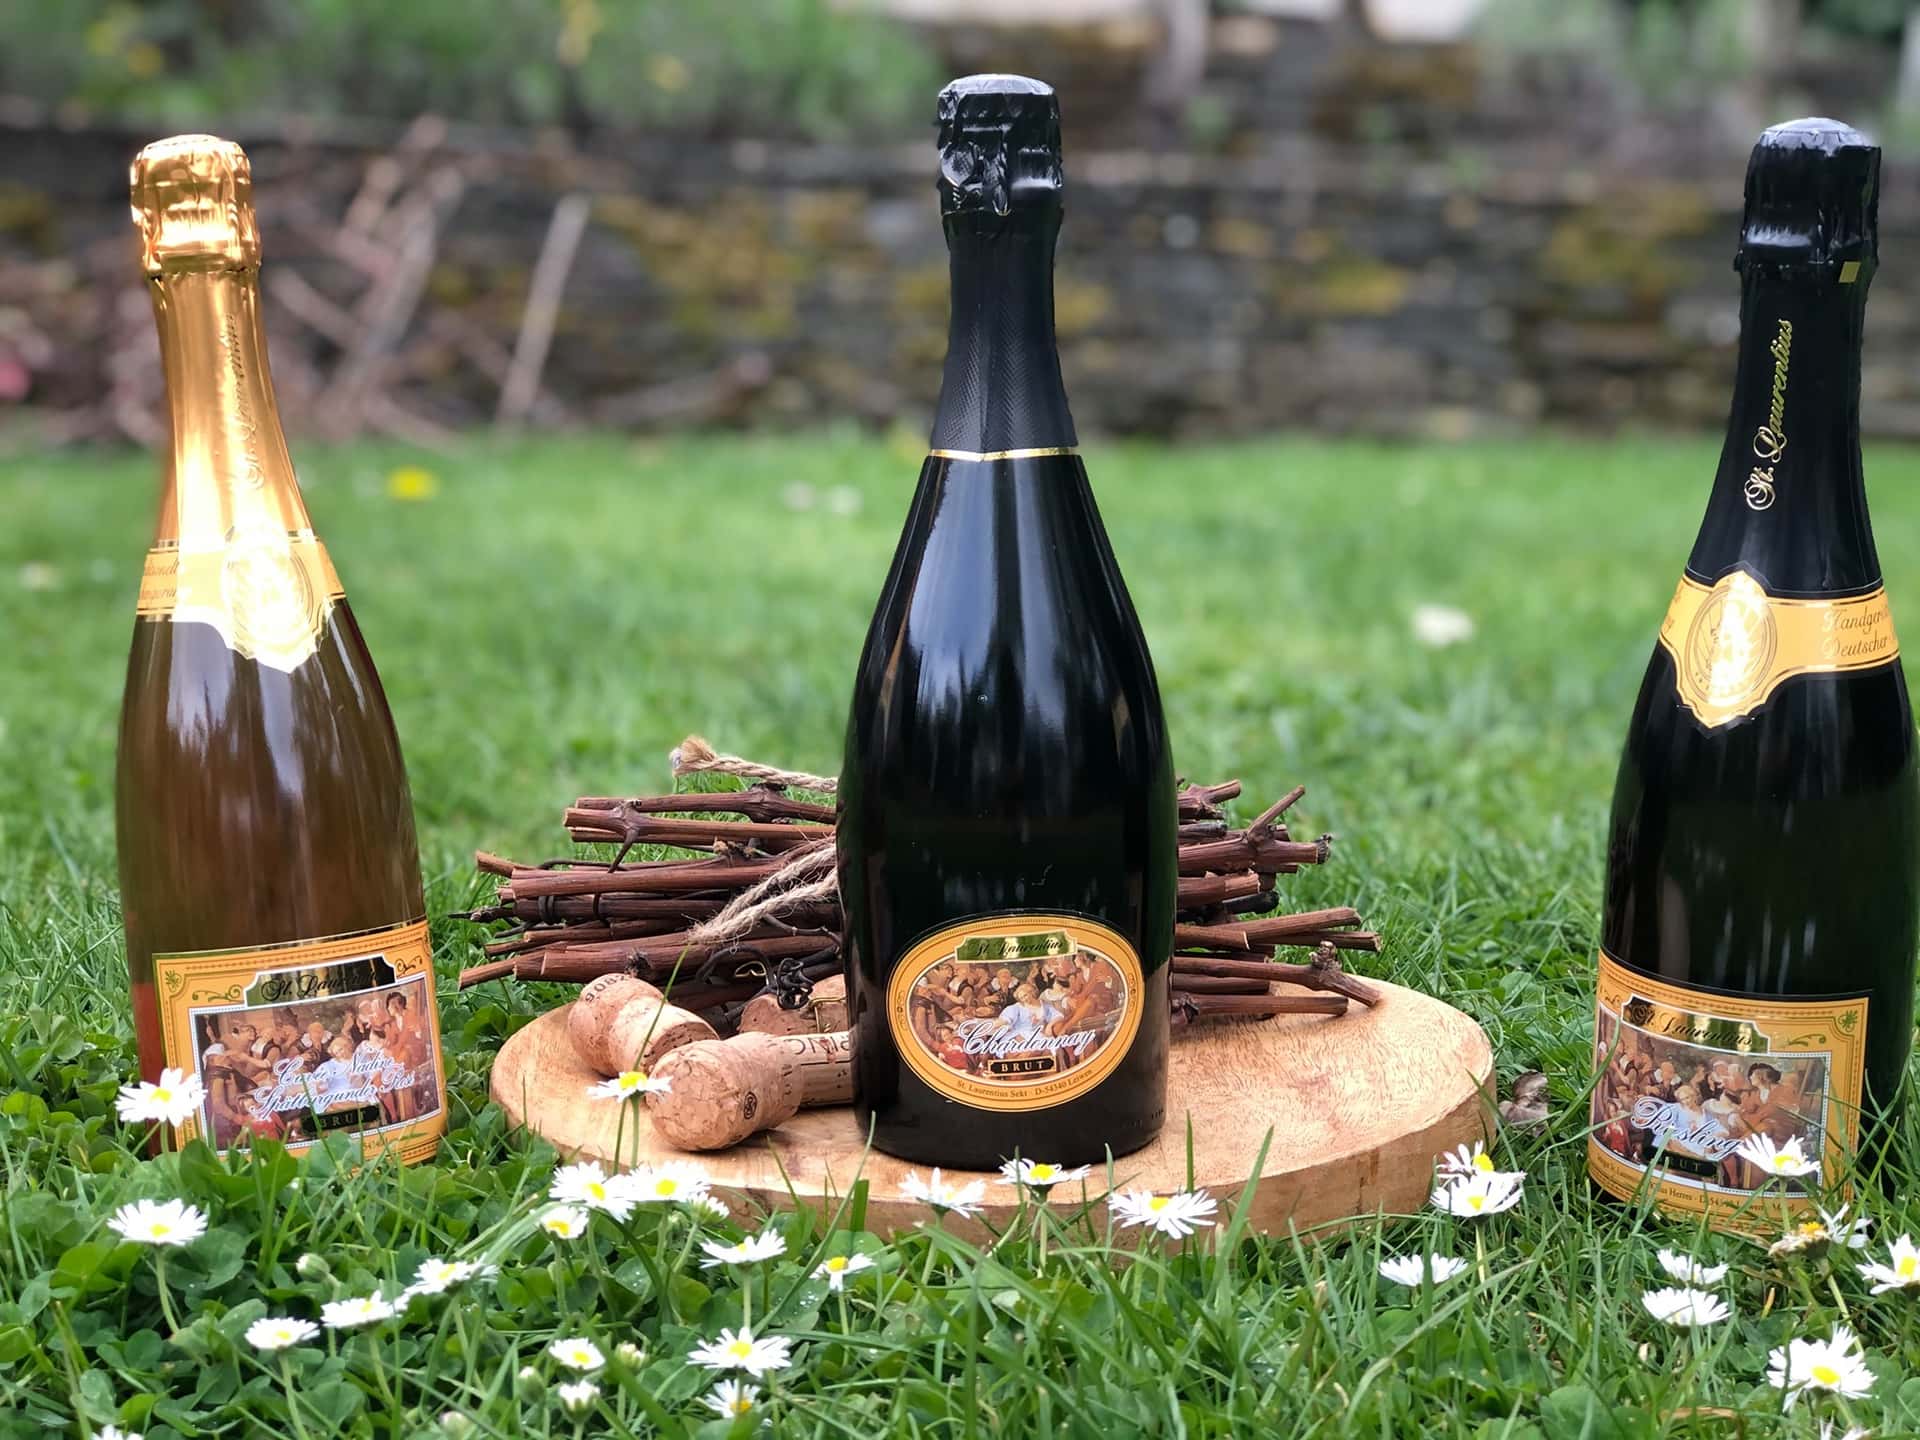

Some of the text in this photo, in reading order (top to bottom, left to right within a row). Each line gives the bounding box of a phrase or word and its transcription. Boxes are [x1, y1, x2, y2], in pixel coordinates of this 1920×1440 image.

[1744, 318, 1793, 511] St. Laurentius
[959, 1020, 1096, 1059] Chardonnay
[1659, 1011, 1752, 1046] Laurentius
[1001, 1060, 1046, 1073] BRUT
